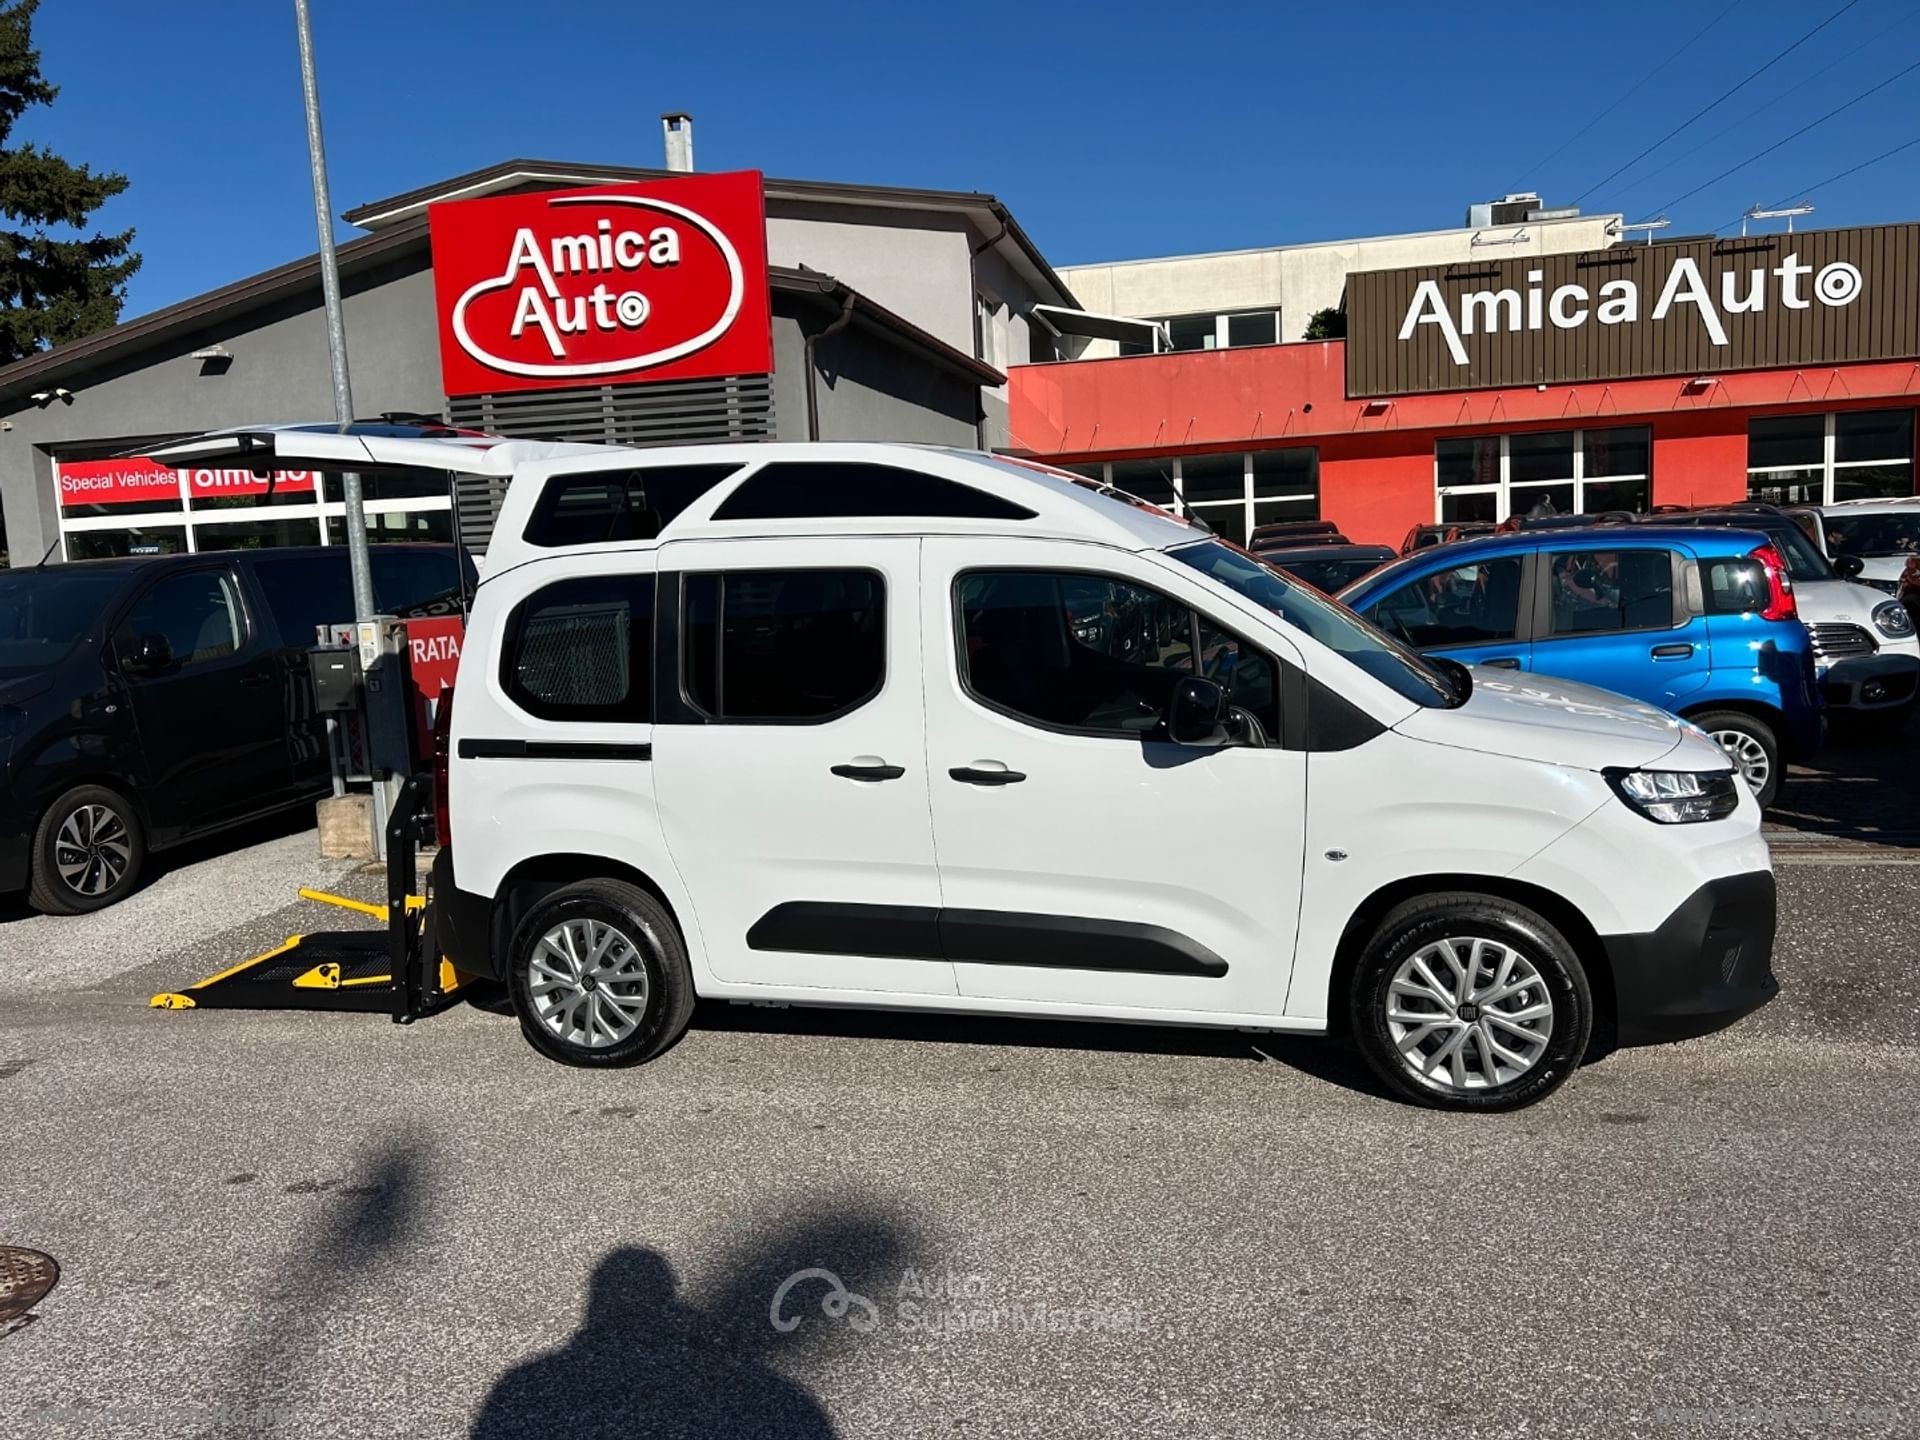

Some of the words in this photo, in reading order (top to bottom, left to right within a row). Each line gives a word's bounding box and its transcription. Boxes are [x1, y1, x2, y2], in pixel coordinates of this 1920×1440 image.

[503, 219, 680, 298] Amica
[510, 283, 650, 357] Auto
[1398, 269, 1638, 366] Amica
[1651, 252, 1863, 346] Auto
[62, 472, 113, 494] Special
[115, 469, 177, 488] Vehicles
[408, 635, 460, 664] RATA
